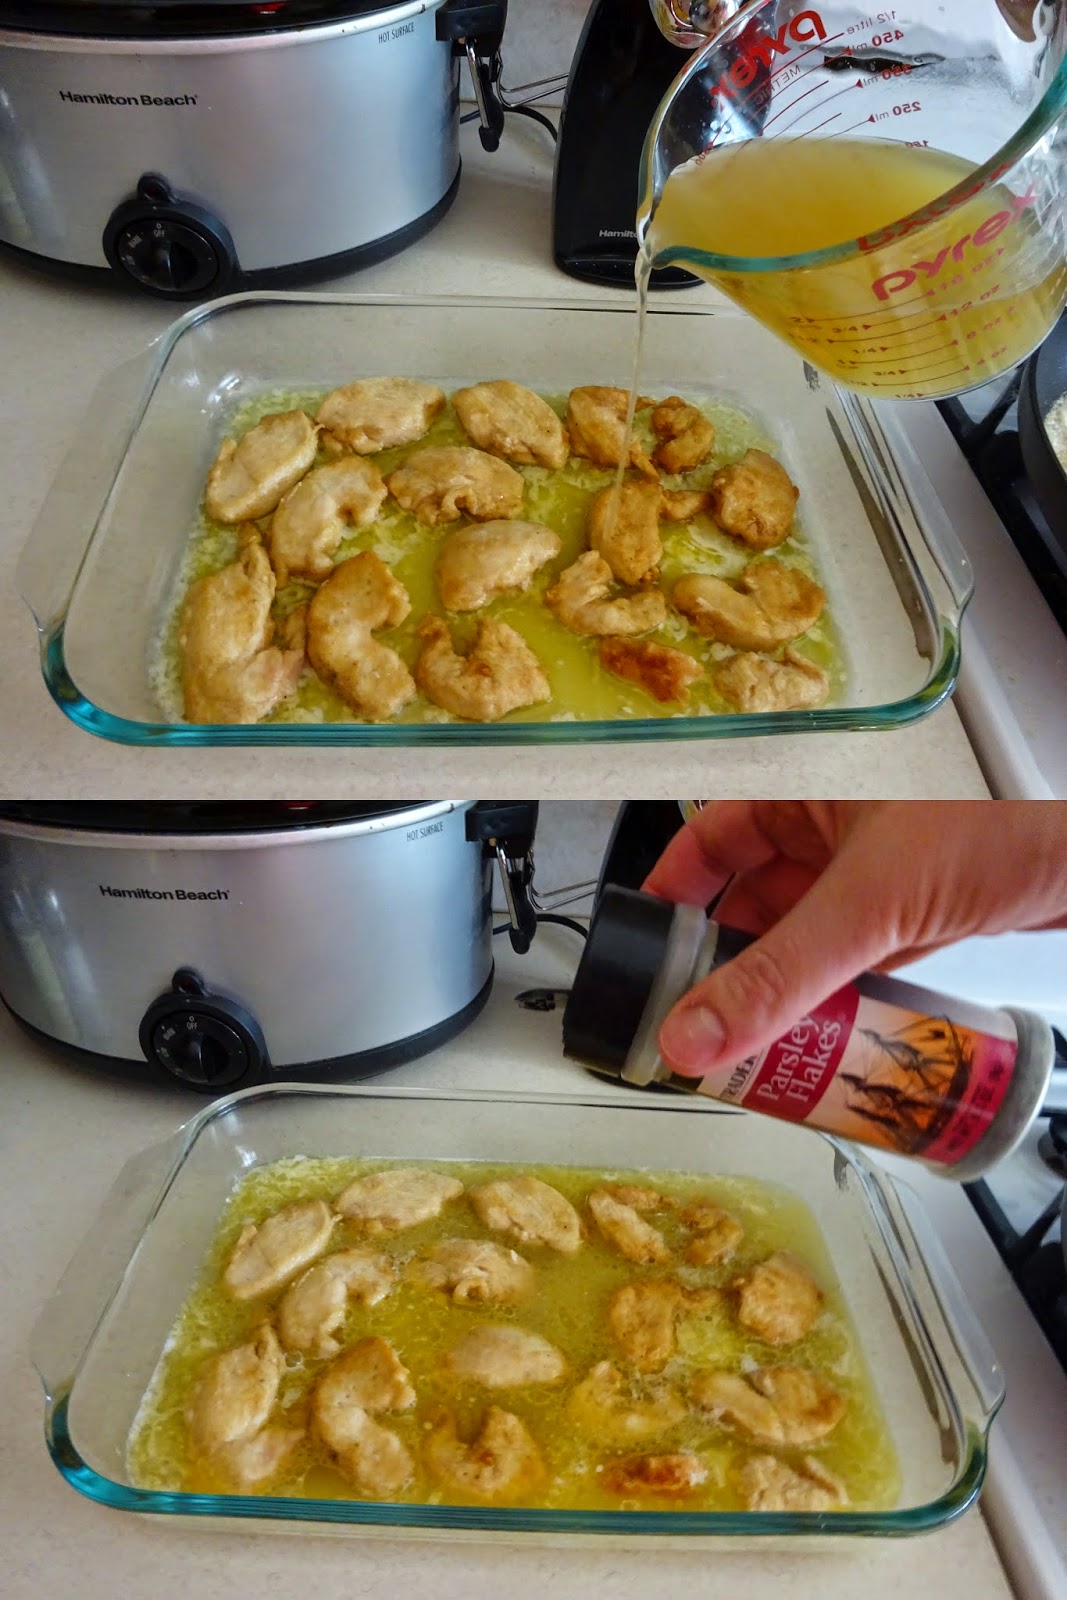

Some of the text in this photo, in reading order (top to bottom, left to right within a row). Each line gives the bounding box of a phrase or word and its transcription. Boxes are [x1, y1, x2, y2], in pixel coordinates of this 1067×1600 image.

[378, 22, 415, 44] HOT SURFACE
[59, 90, 197, 106] Hamilton Beach
[153, 230, 166, 238] OFF
[871, 178, 1038, 302] pyrex
[406, 821, 443, 842] HOT SURFACE
[99, 885, 229, 901] Hamilton Beach
[186, 1022, 198, 1030] OFF
[756, 1016, 820, 1101] Parsley
[786, 1020, 841, 1102] Flakes
